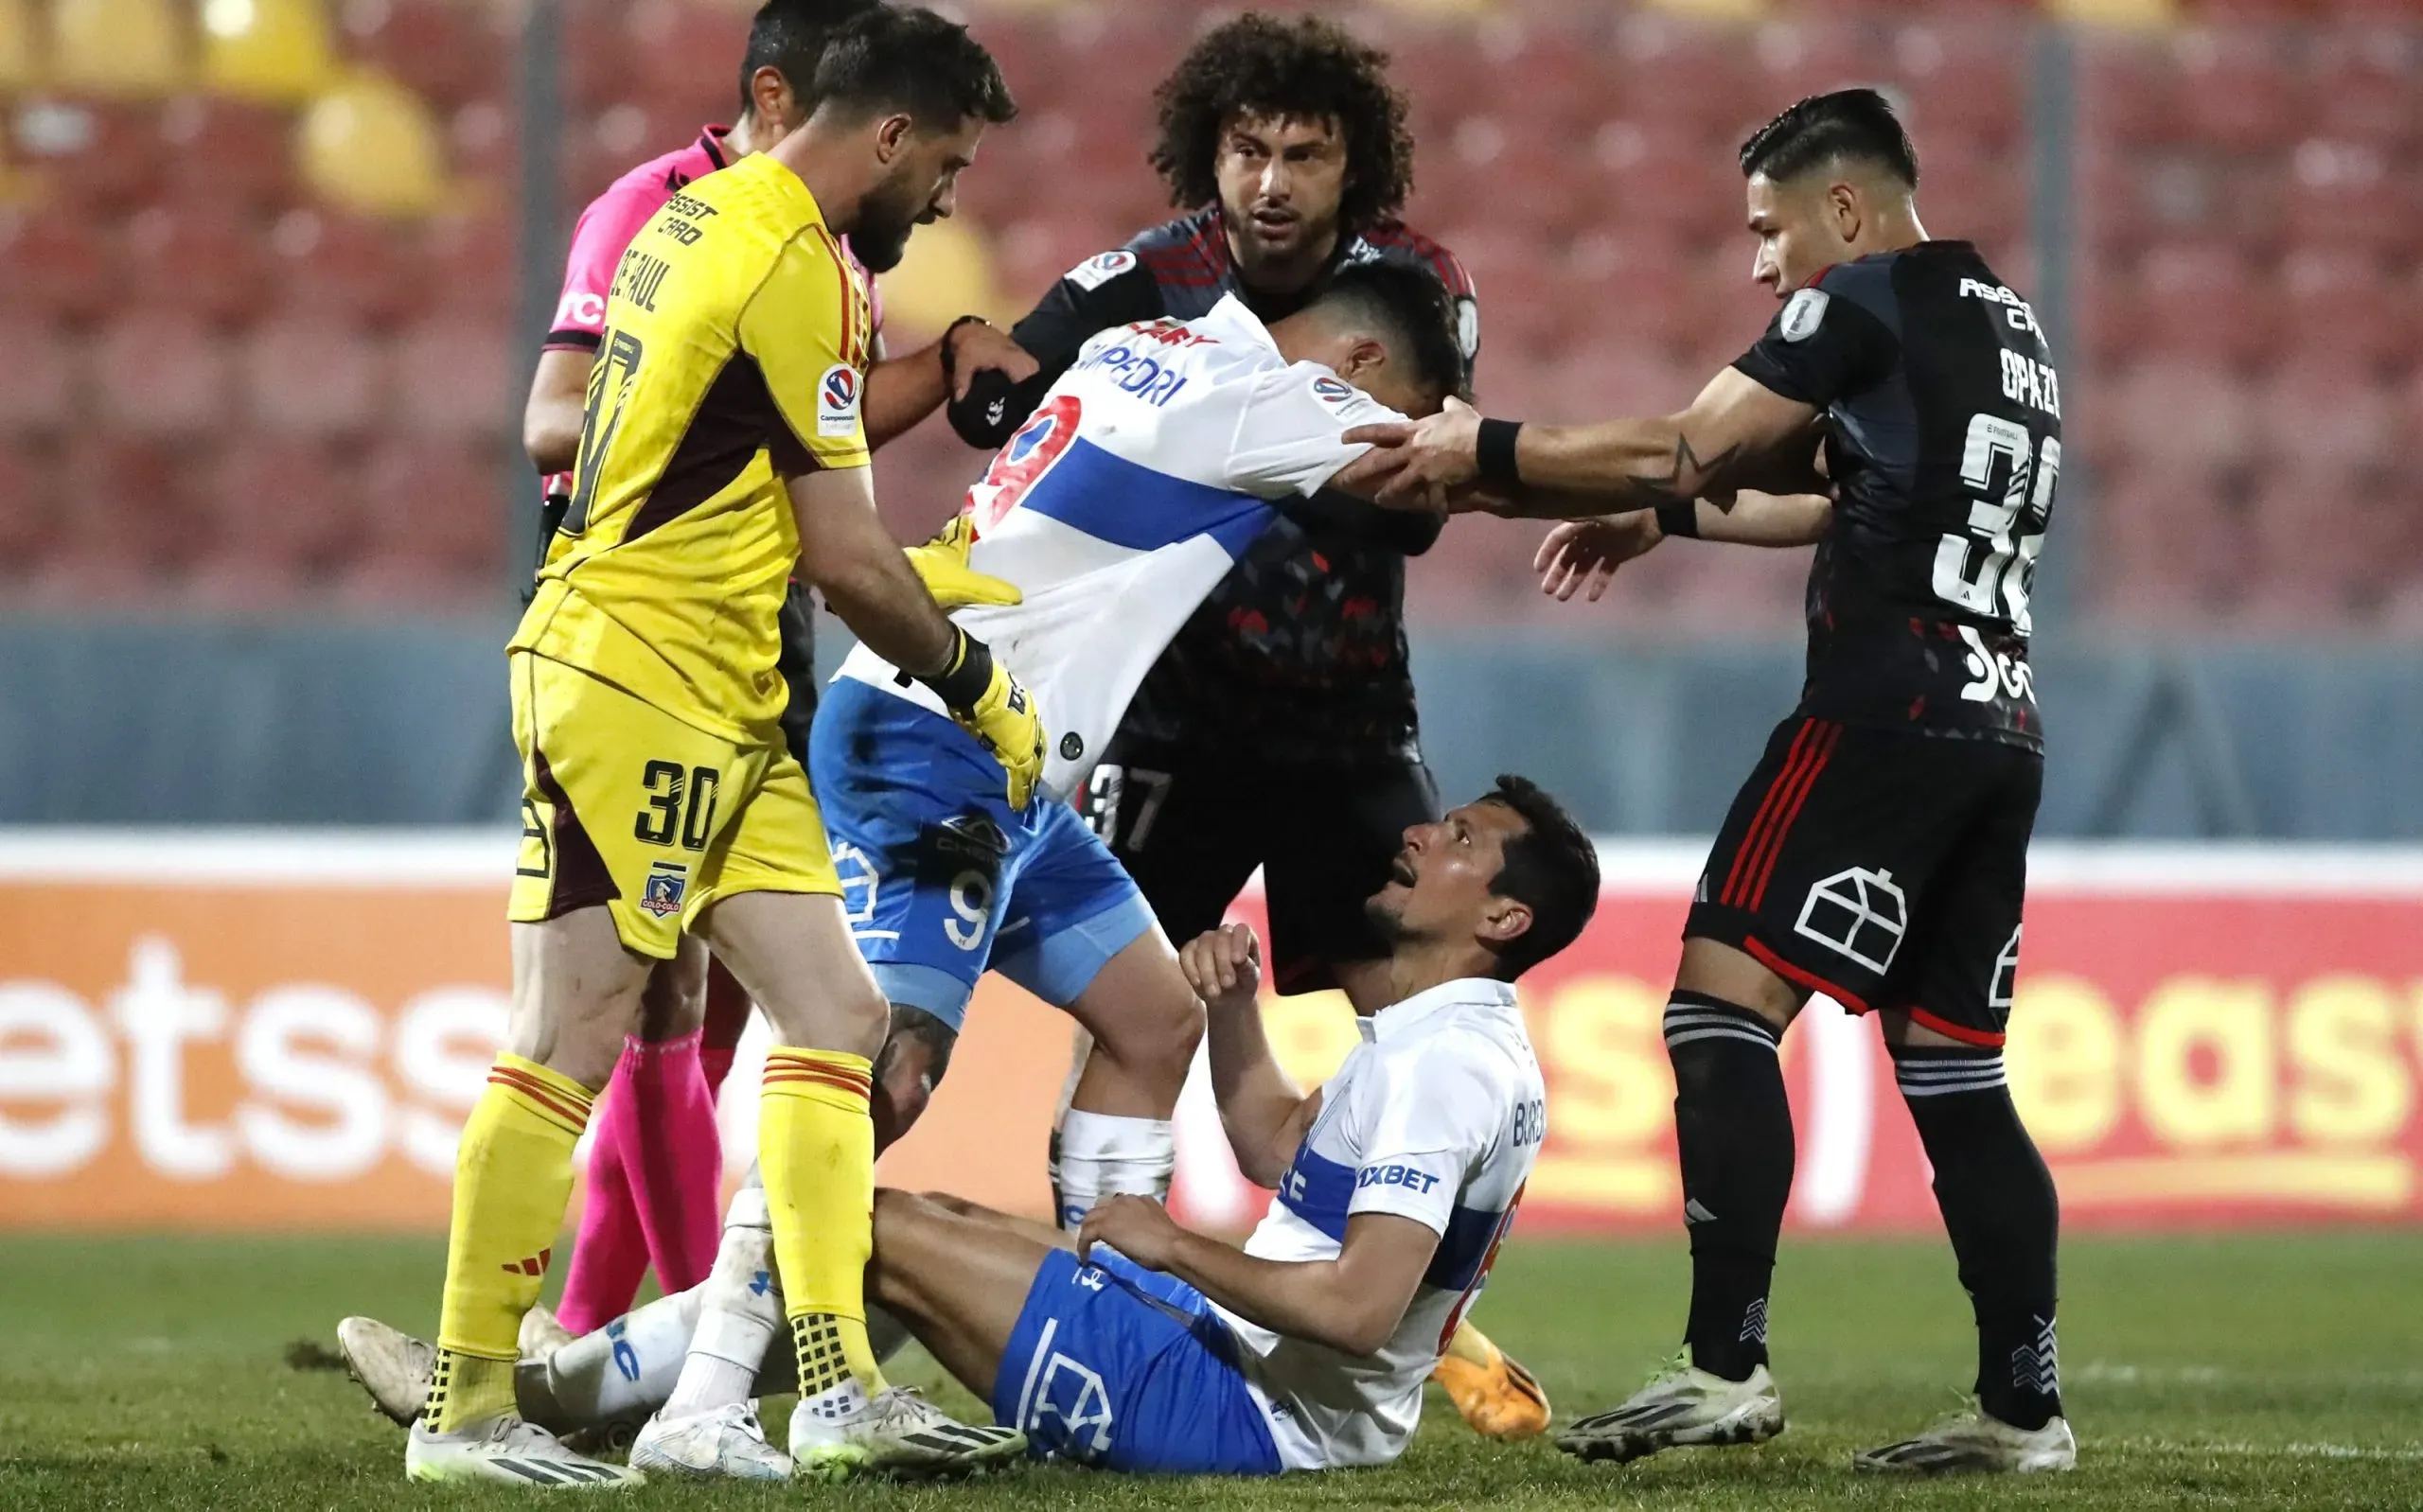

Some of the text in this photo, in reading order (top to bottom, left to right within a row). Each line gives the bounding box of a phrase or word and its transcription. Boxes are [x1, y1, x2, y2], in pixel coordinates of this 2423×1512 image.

[658, 217, 703, 247] CARD
[634, 759, 720, 852] 30
[1084, 763, 1174, 853] 37
[642, 899, 680, 913] COLO-COLO
[943, 869, 993, 952] 9
[1358, 1164, 1441, 1195] 1XBET
